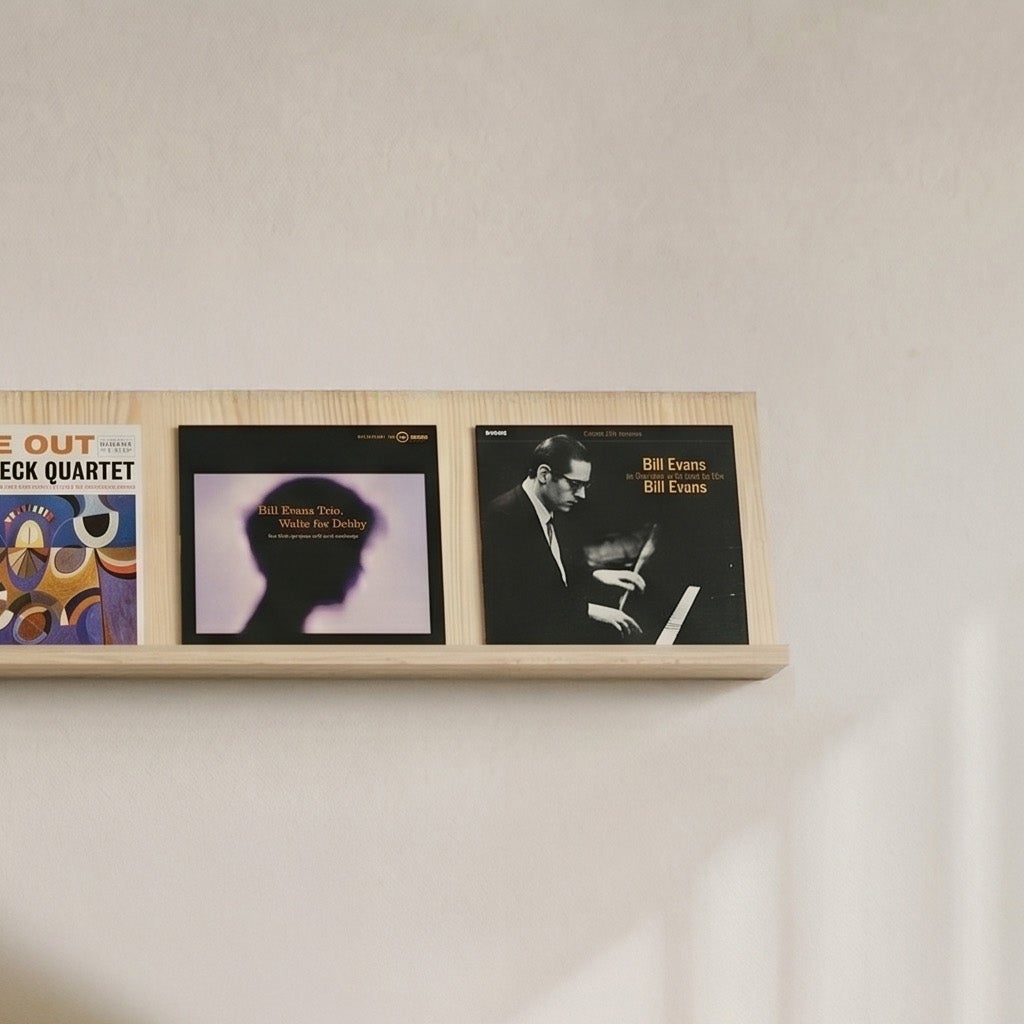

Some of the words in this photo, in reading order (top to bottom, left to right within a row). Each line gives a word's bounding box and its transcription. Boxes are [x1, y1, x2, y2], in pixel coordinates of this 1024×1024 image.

[24, 434, 95, 455] OUT
[642, 457, 664, 471] Bill
[667, 457, 707, 471] Evans
[44, 460, 135, 485] QUARTET
[644, 479, 665, 494] Bill
[668, 479, 708, 494] Evans
[258, 505, 279, 515] Bill
